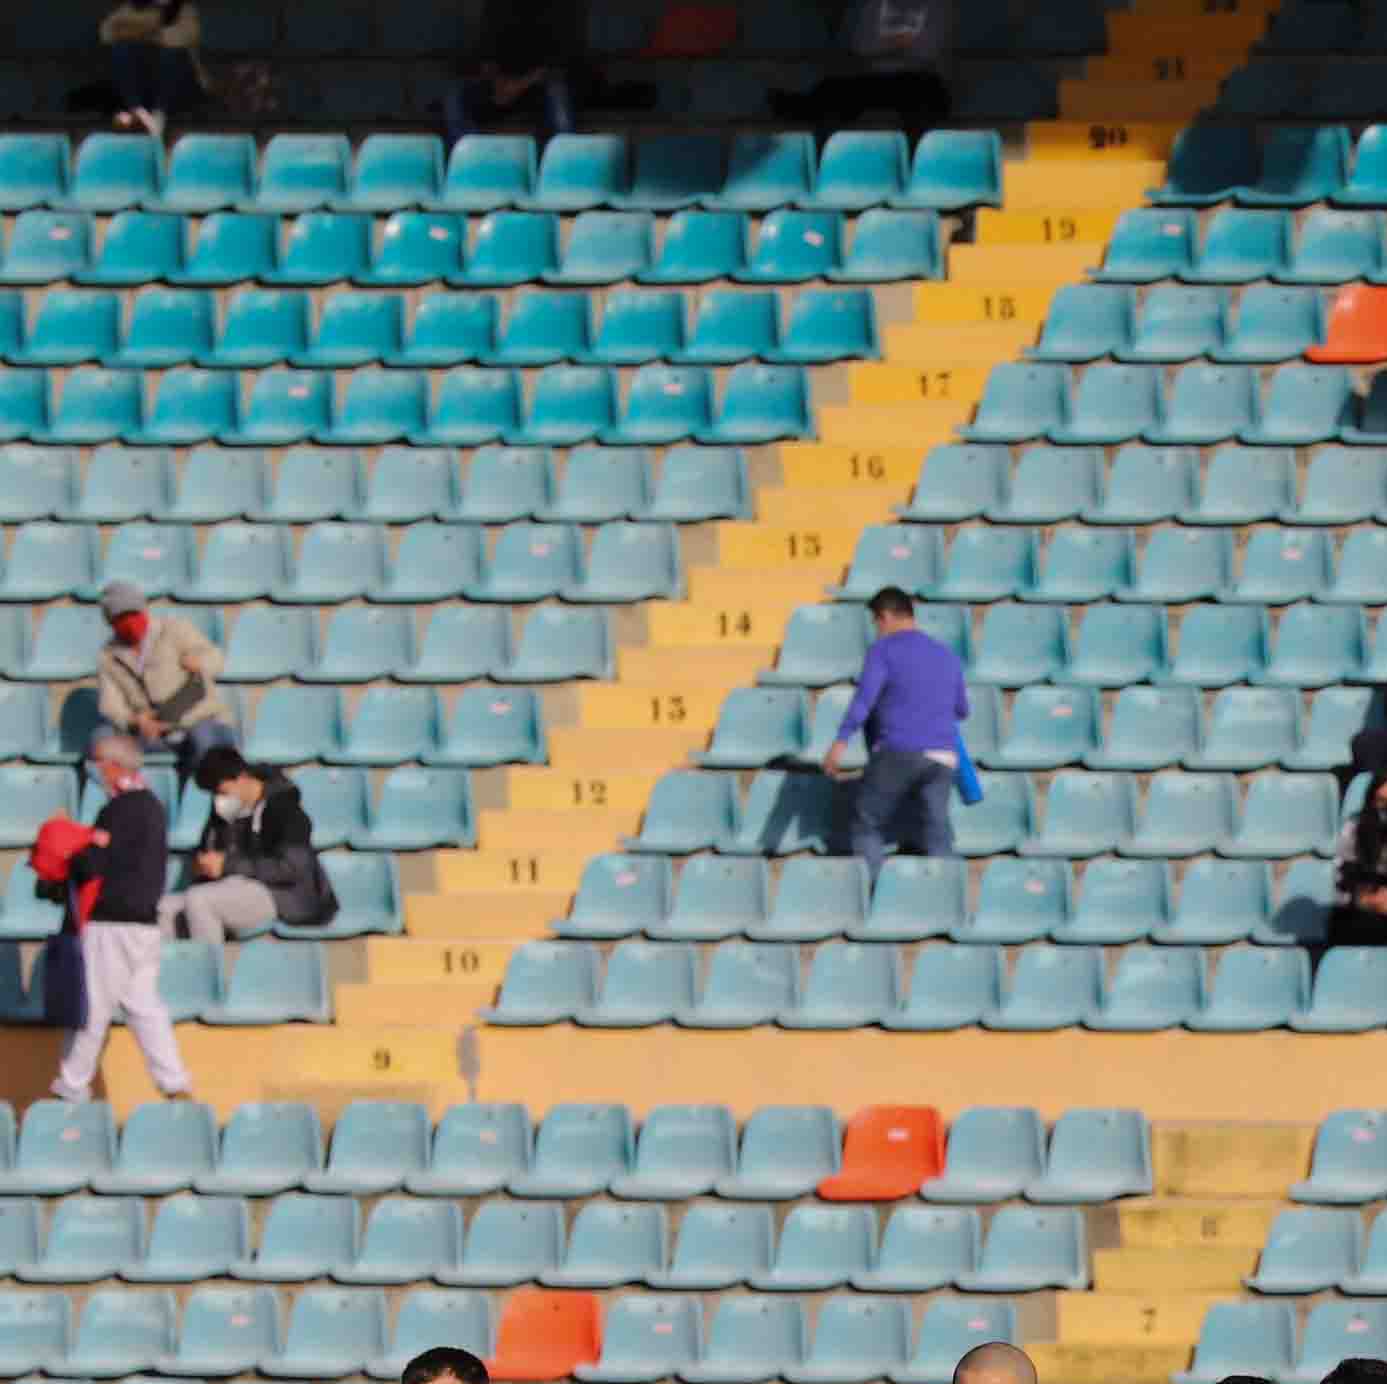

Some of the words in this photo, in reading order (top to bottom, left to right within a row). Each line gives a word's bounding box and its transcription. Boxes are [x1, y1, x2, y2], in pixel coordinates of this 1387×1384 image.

[1042, 217, 1077, 242] 19
[850, 455, 885, 480] 16
[719, 612, 752, 637] 14
[572, 780, 607, 805] 12
[510, 858, 538, 882] 11
[443, 950, 480, 973] 10
